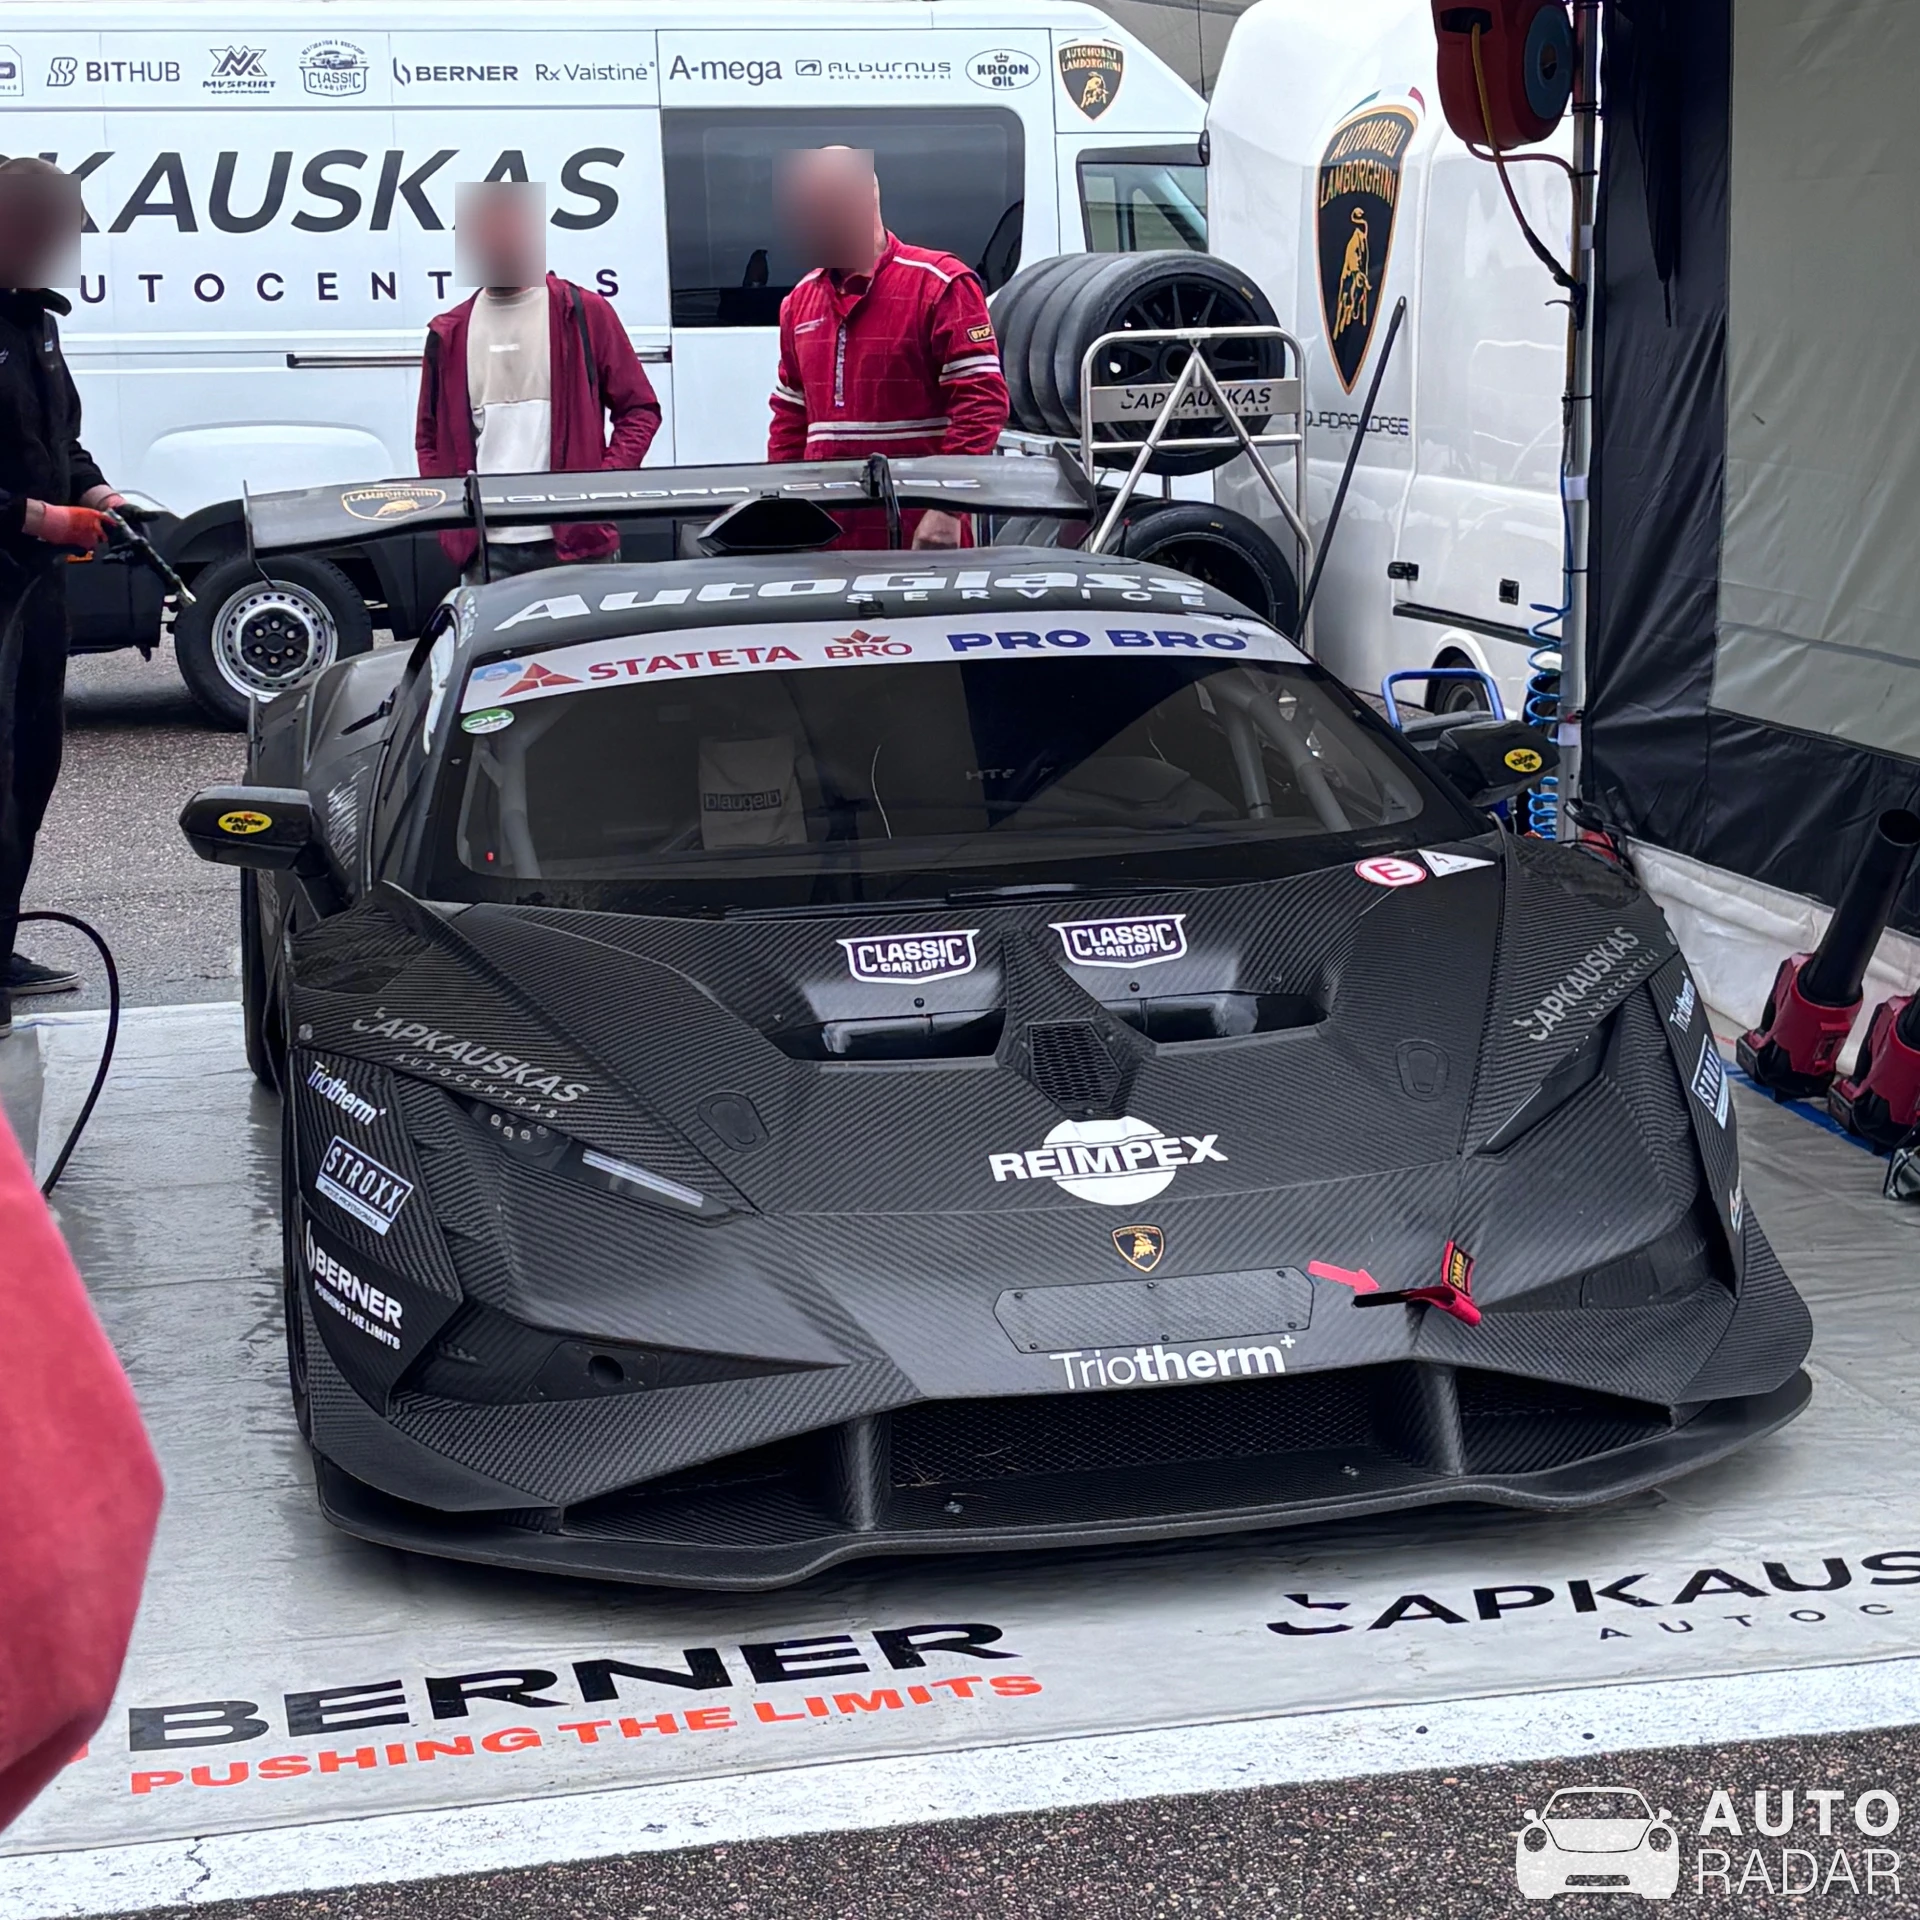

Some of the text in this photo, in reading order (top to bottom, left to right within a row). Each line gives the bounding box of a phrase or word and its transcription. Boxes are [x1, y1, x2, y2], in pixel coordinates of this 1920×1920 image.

[86, 61, 181, 82] BITHUB
[202, 80, 276, 89] MVSPORT
[309, 72, 361, 88] CLASSIC
[416, 65, 518, 81] BERNER
[535, 63, 560, 81] Rx
[669, 55, 783, 86] A-mega
[977, 64, 1029, 75] KROON
[991, 76, 1015, 87] OIL
[1330, 119, 1406, 163] AUTOMOBILI
[1320, 159, 1397, 208] LAMBORGHINI
[846, 588, 1207, 606] SERVICE
[824, 640, 912, 660] BRO
[946, 628, 1247, 652] PRO BRO
[588, 646, 803, 681] STATETA
[1368, 861, 1415, 881] E
[1070, 923, 1177, 957] CLASSIC
[1095, 942, 1158, 957] CAR LOFT
[857, 938, 966, 973] CLASSIC
[880, 959, 946, 973] CAR LOFT
[396, 1053, 558, 1119] AUTOCENTRAS
[988, 1133, 1229, 1182] REIMPEX
[326, 1146, 404, 1214] STROXX
[1453, 1252, 1465, 1288] OMP
[315, 1246, 402, 1330] BERNER
[365, 1320, 401, 1350] LIMITS
[128, 1622, 1023, 1752] BERNER
[131, 1675, 1043, 1795] PUSHING THE LIMITS
